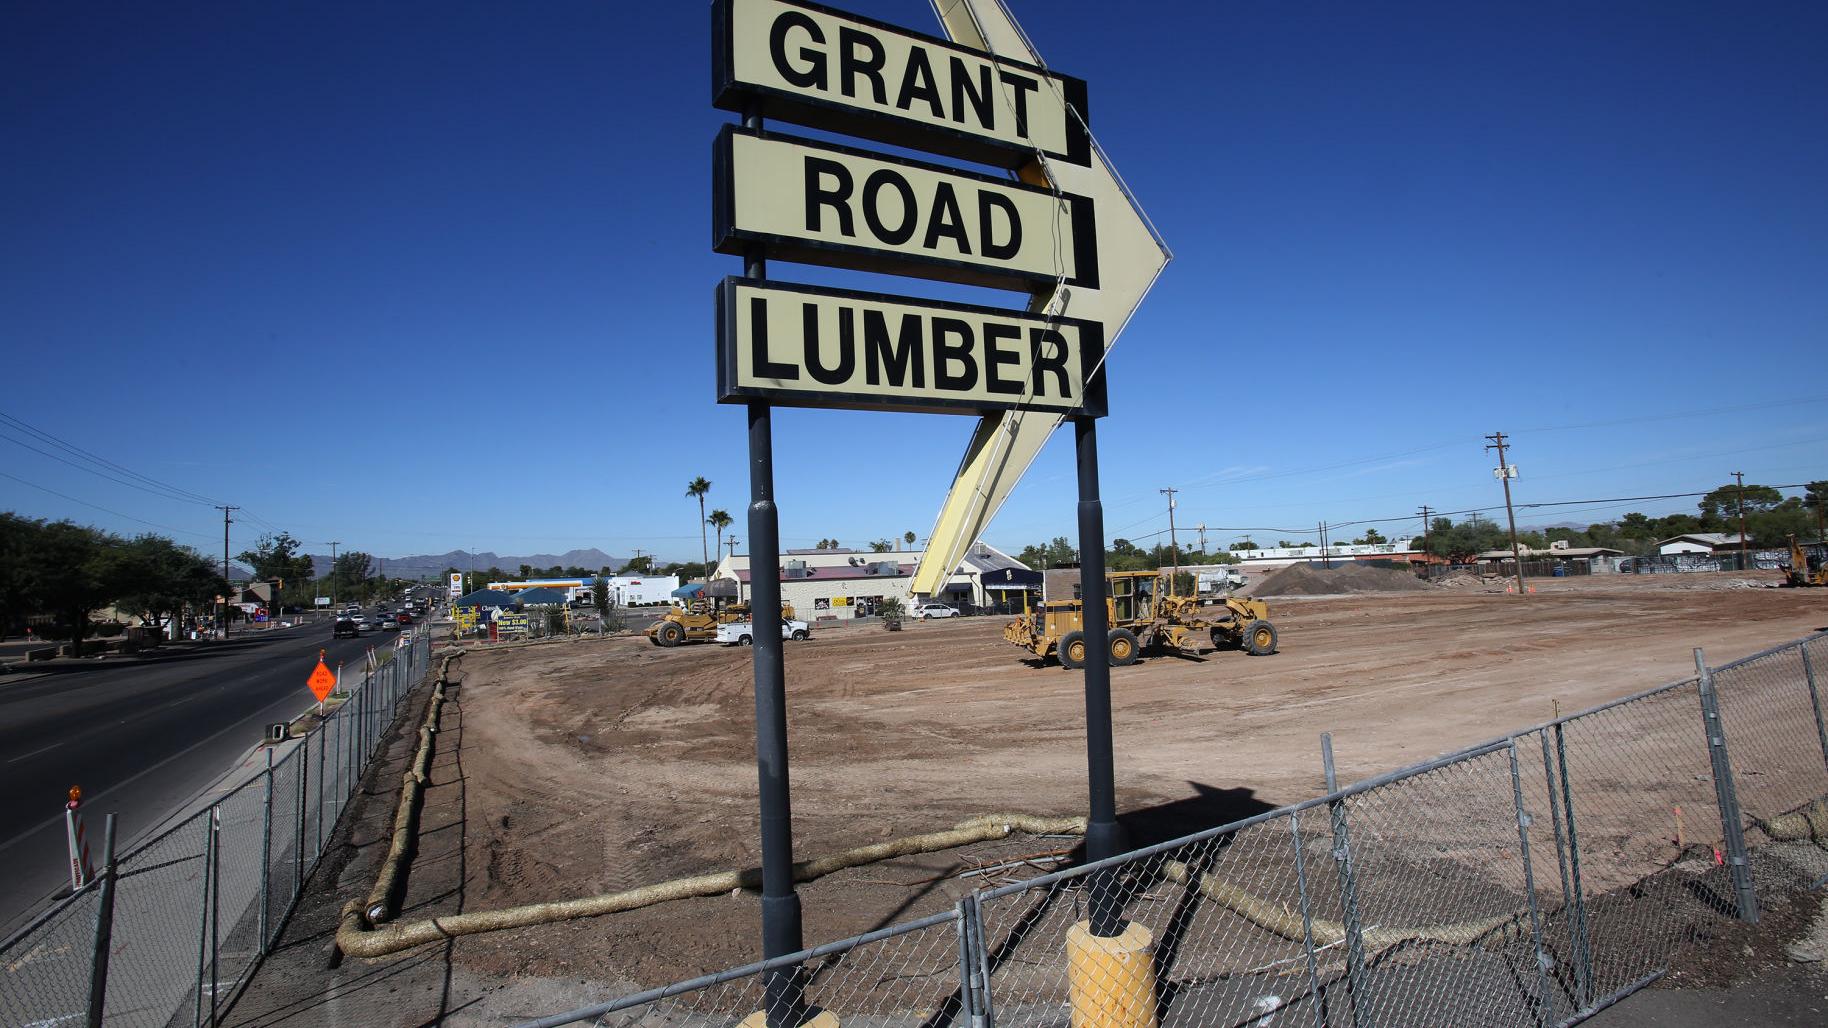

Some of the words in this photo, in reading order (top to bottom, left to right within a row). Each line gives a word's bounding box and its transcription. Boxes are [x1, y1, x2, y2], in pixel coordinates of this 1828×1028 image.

[769, 10, 1039, 140] GRANT
[804, 155, 1023, 261] ROAD
[750, 297, 1072, 399] LUMBER
